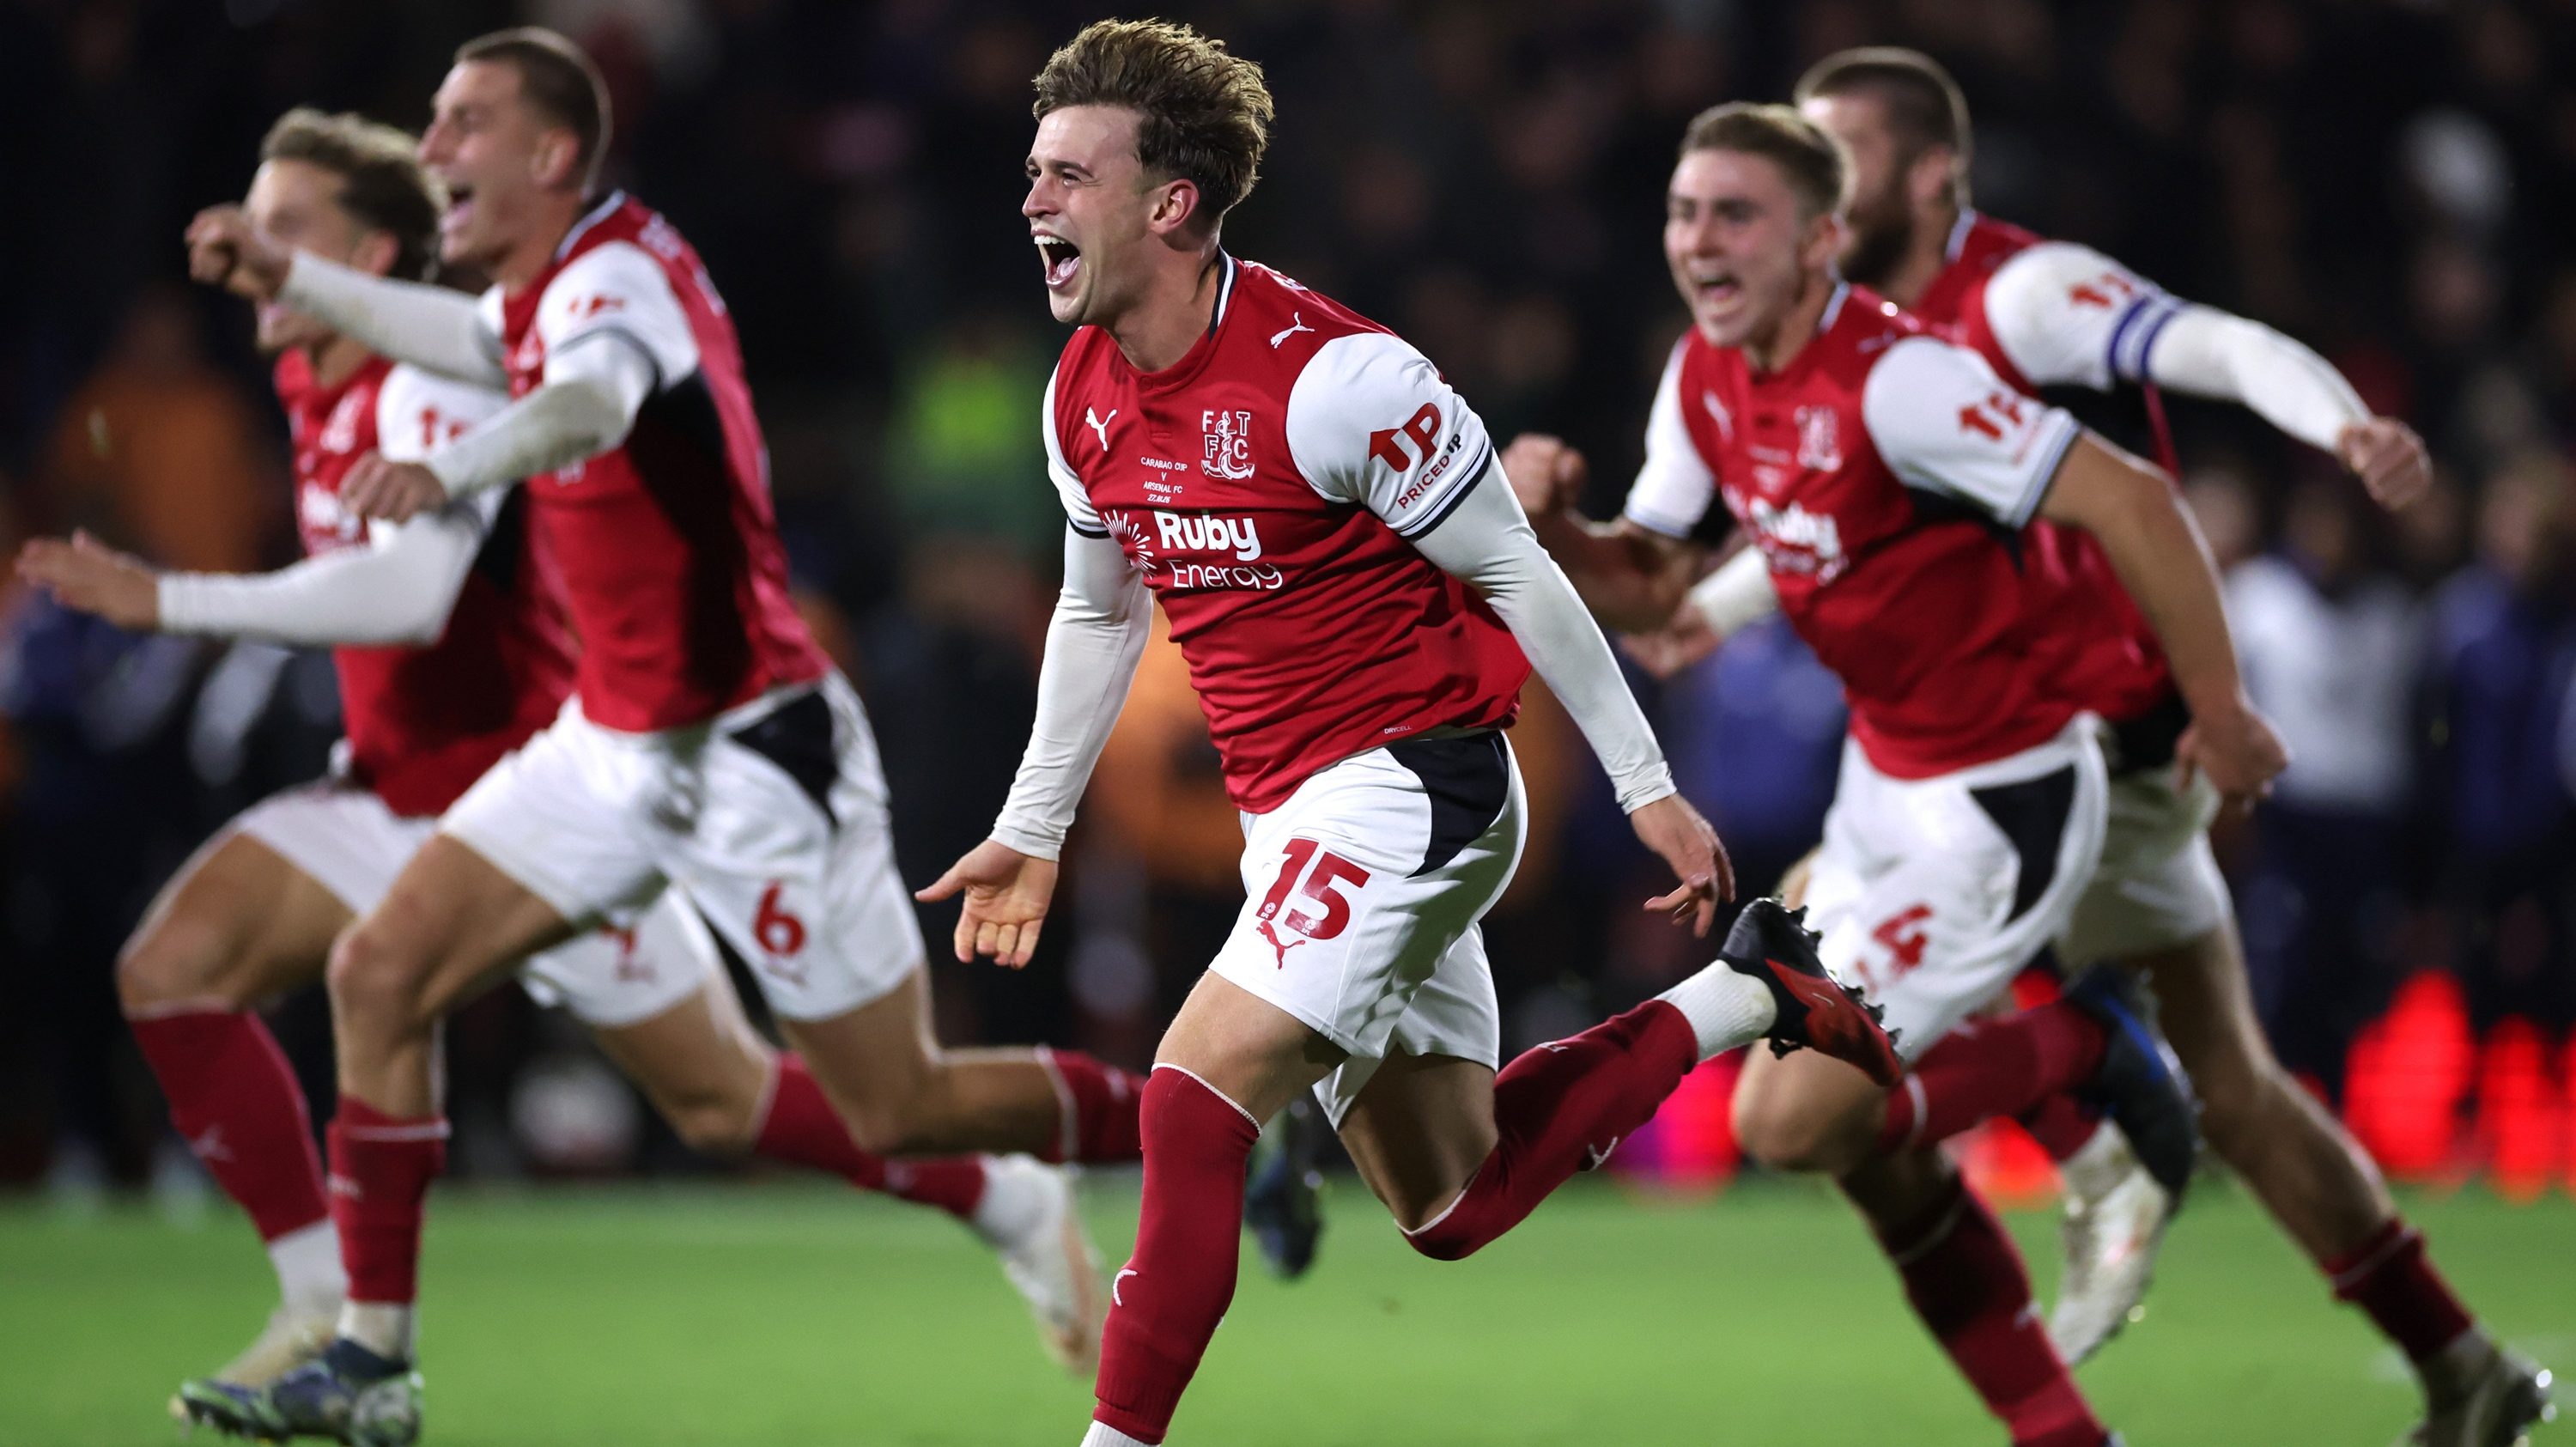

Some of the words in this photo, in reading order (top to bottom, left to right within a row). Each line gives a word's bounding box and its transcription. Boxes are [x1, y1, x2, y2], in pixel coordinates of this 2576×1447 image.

[1140, 457, 1173, 470] CARABAO
[1175, 462, 1188, 471] CUP
[1161, 471, 1167, 481] V
[1143, 481, 1172, 493] ARSENAL
[1173, 485, 1182, 494] FC
[1154, 509, 1261, 562] Ruby
[1166, 559, 1283, 590] Energy
[1384, 726, 1413, 734] DRYCELL
[1255, 838, 1371, 940] 15
[753, 879, 806, 958] 6
